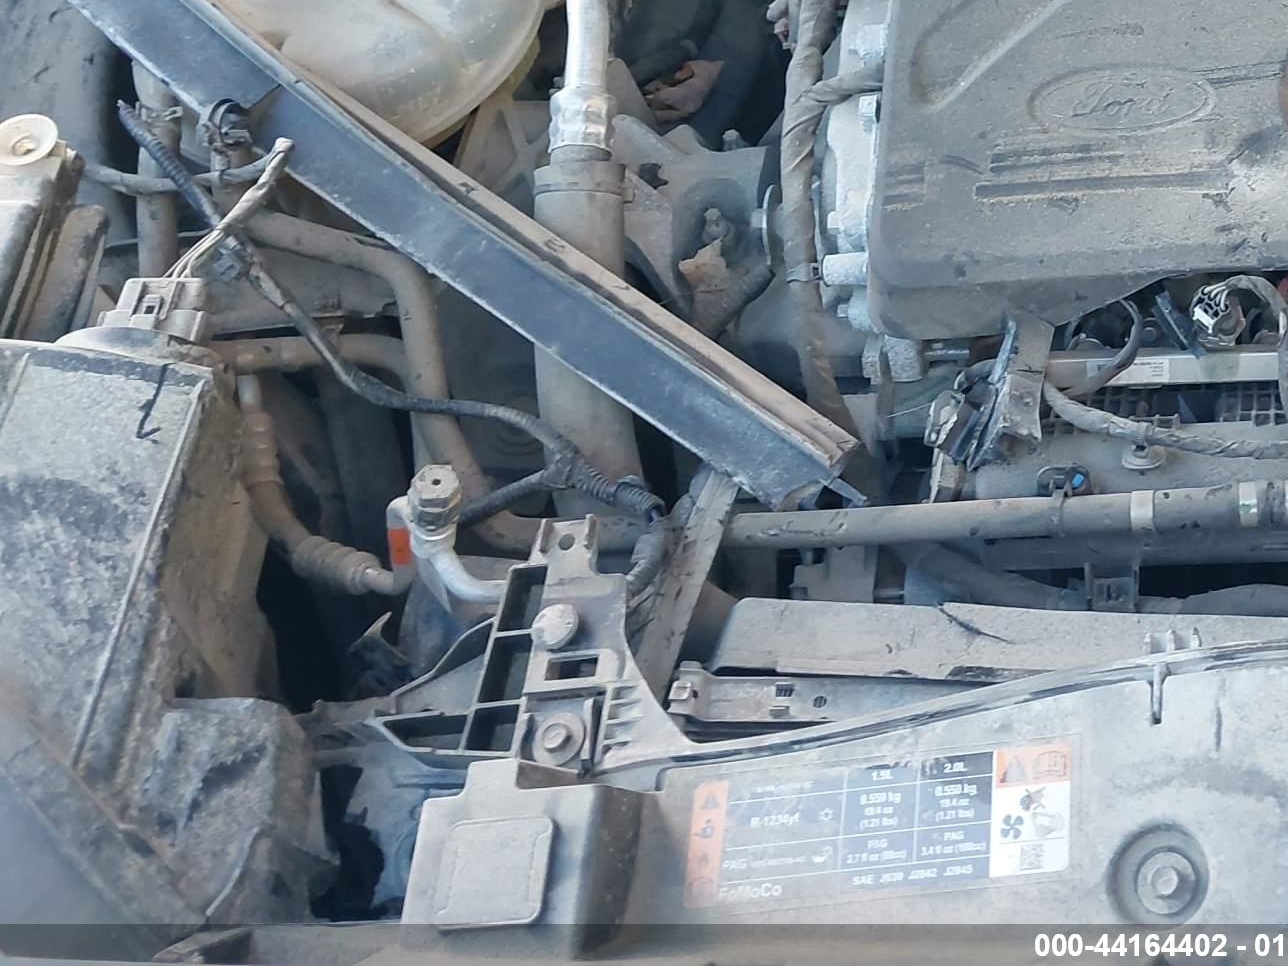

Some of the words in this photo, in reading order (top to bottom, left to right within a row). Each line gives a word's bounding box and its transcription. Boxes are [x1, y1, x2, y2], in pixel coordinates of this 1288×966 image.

[943, 761, 968, 773] 2.0L
[871, 769, 894, 781] 1.5L
[963, 783, 977, 796] kg
[888, 791, 901, 804] kg
[852, 874, 875, 886] SAE
[719, 882, 783, 900] FoMoCo
